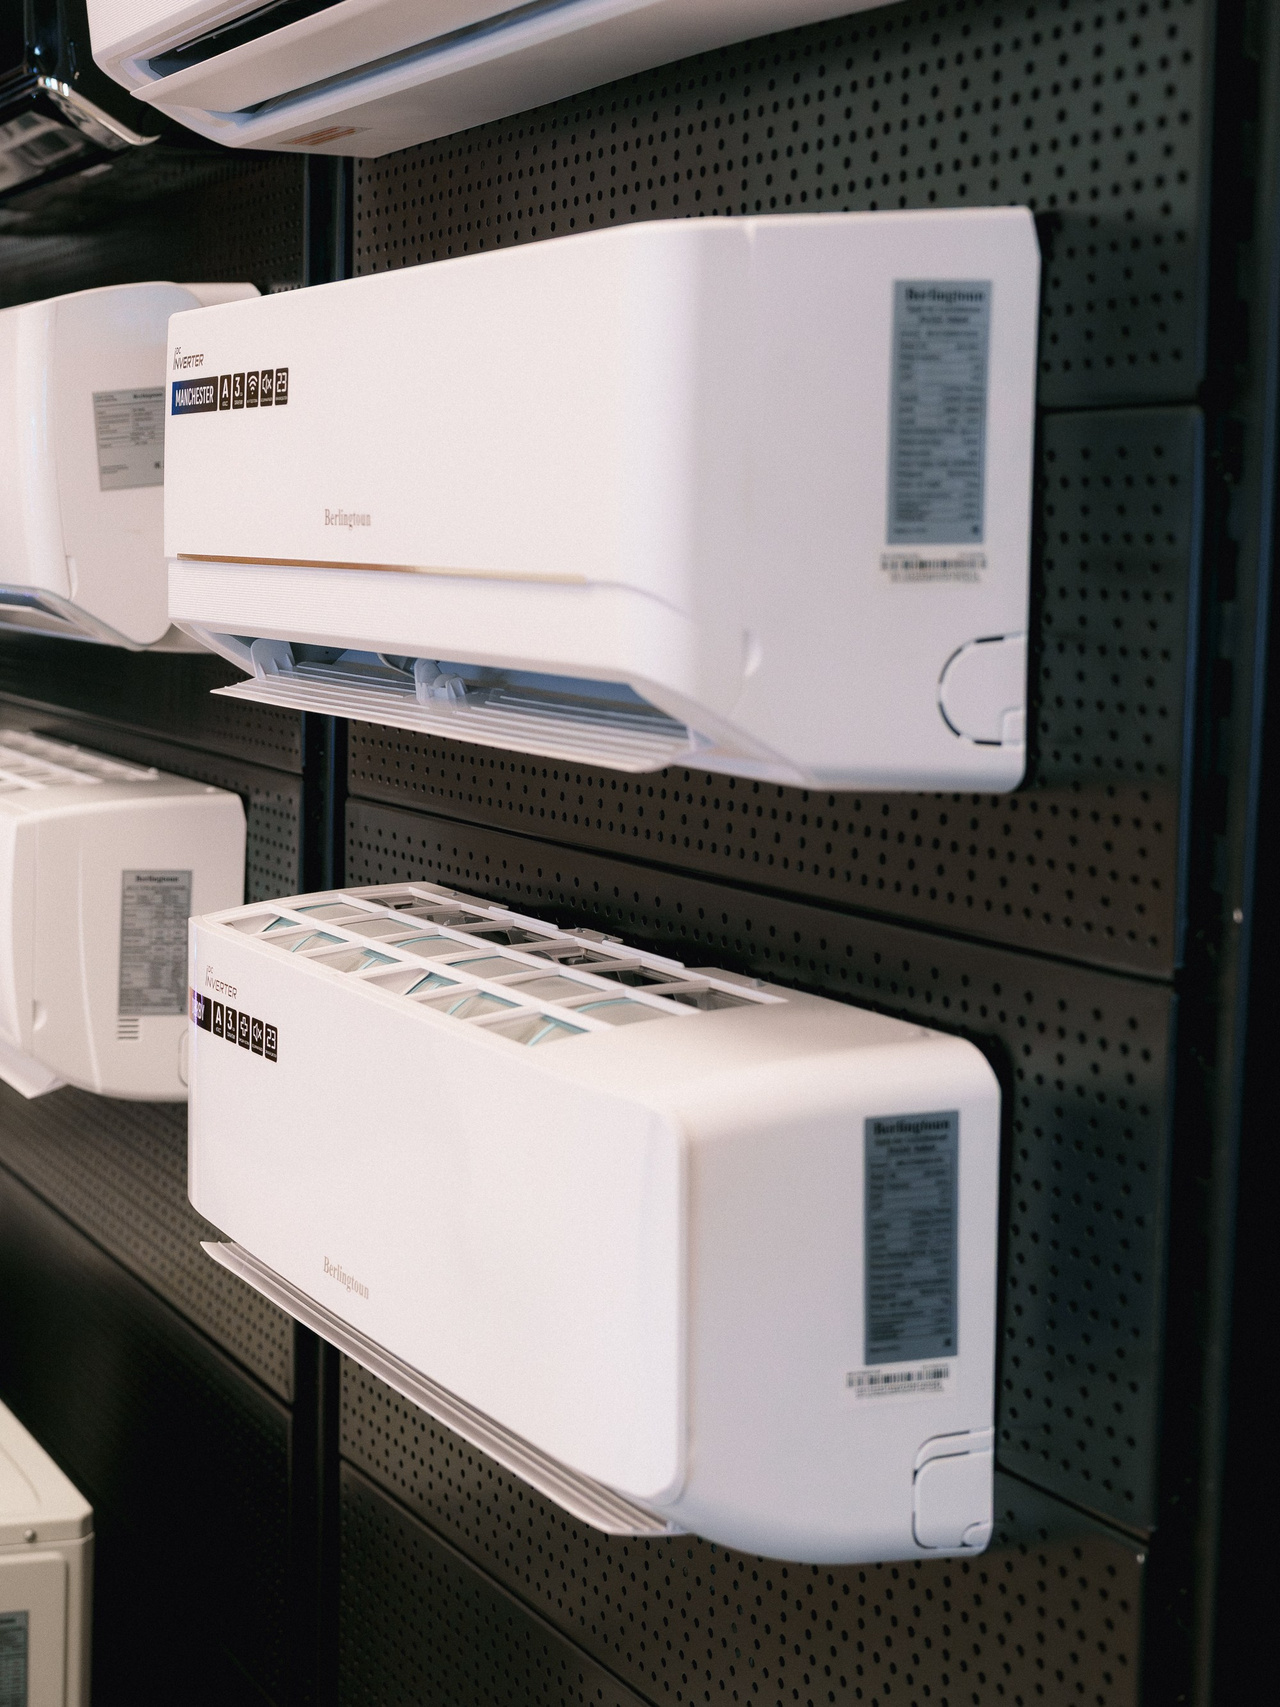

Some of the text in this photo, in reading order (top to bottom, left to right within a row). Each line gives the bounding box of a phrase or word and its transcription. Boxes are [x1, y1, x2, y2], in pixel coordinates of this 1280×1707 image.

[175, 372, 287, 407] MANCHESTER A 3 23
[205, 975, 237, 999] INVERTER
[215, 1005, 222, 1026] A
[227, 1010, 233, 1031] 3
[266, 1028, 277, 1050] 23
[323, 1255, 370, 1300] Berlingtoun
